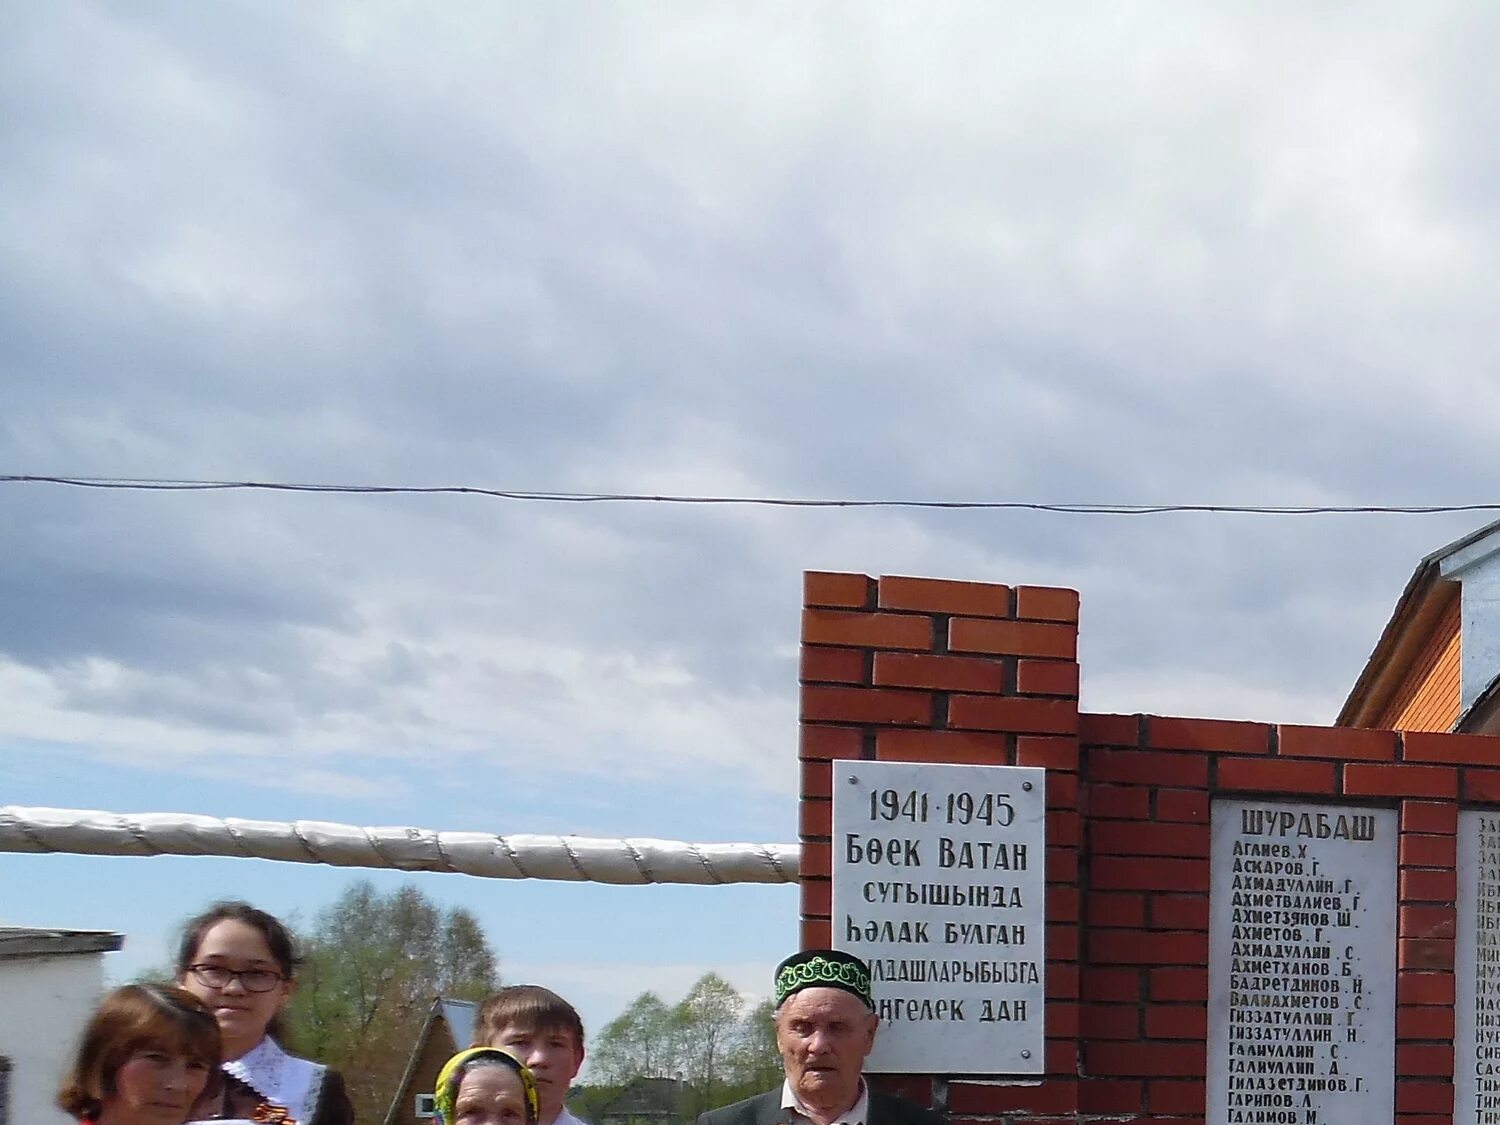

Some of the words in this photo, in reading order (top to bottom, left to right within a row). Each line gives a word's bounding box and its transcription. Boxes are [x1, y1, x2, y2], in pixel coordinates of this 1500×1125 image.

[1241, 809, 1375, 841] ШУРАБАШ
[938, 837, 1027, 871] ВАТАН
[863, 881, 1023, 909] СУГЫШЫНДА
[944, 921, 1025, 946] БУЛГАН
[871, 959, 1040, 984] ЛДАШЛАРЫБЫЗГА
[873, 998, 964, 1027] ҢГЕЛЕК
[979, 1000, 1027, 1022] ДАН
